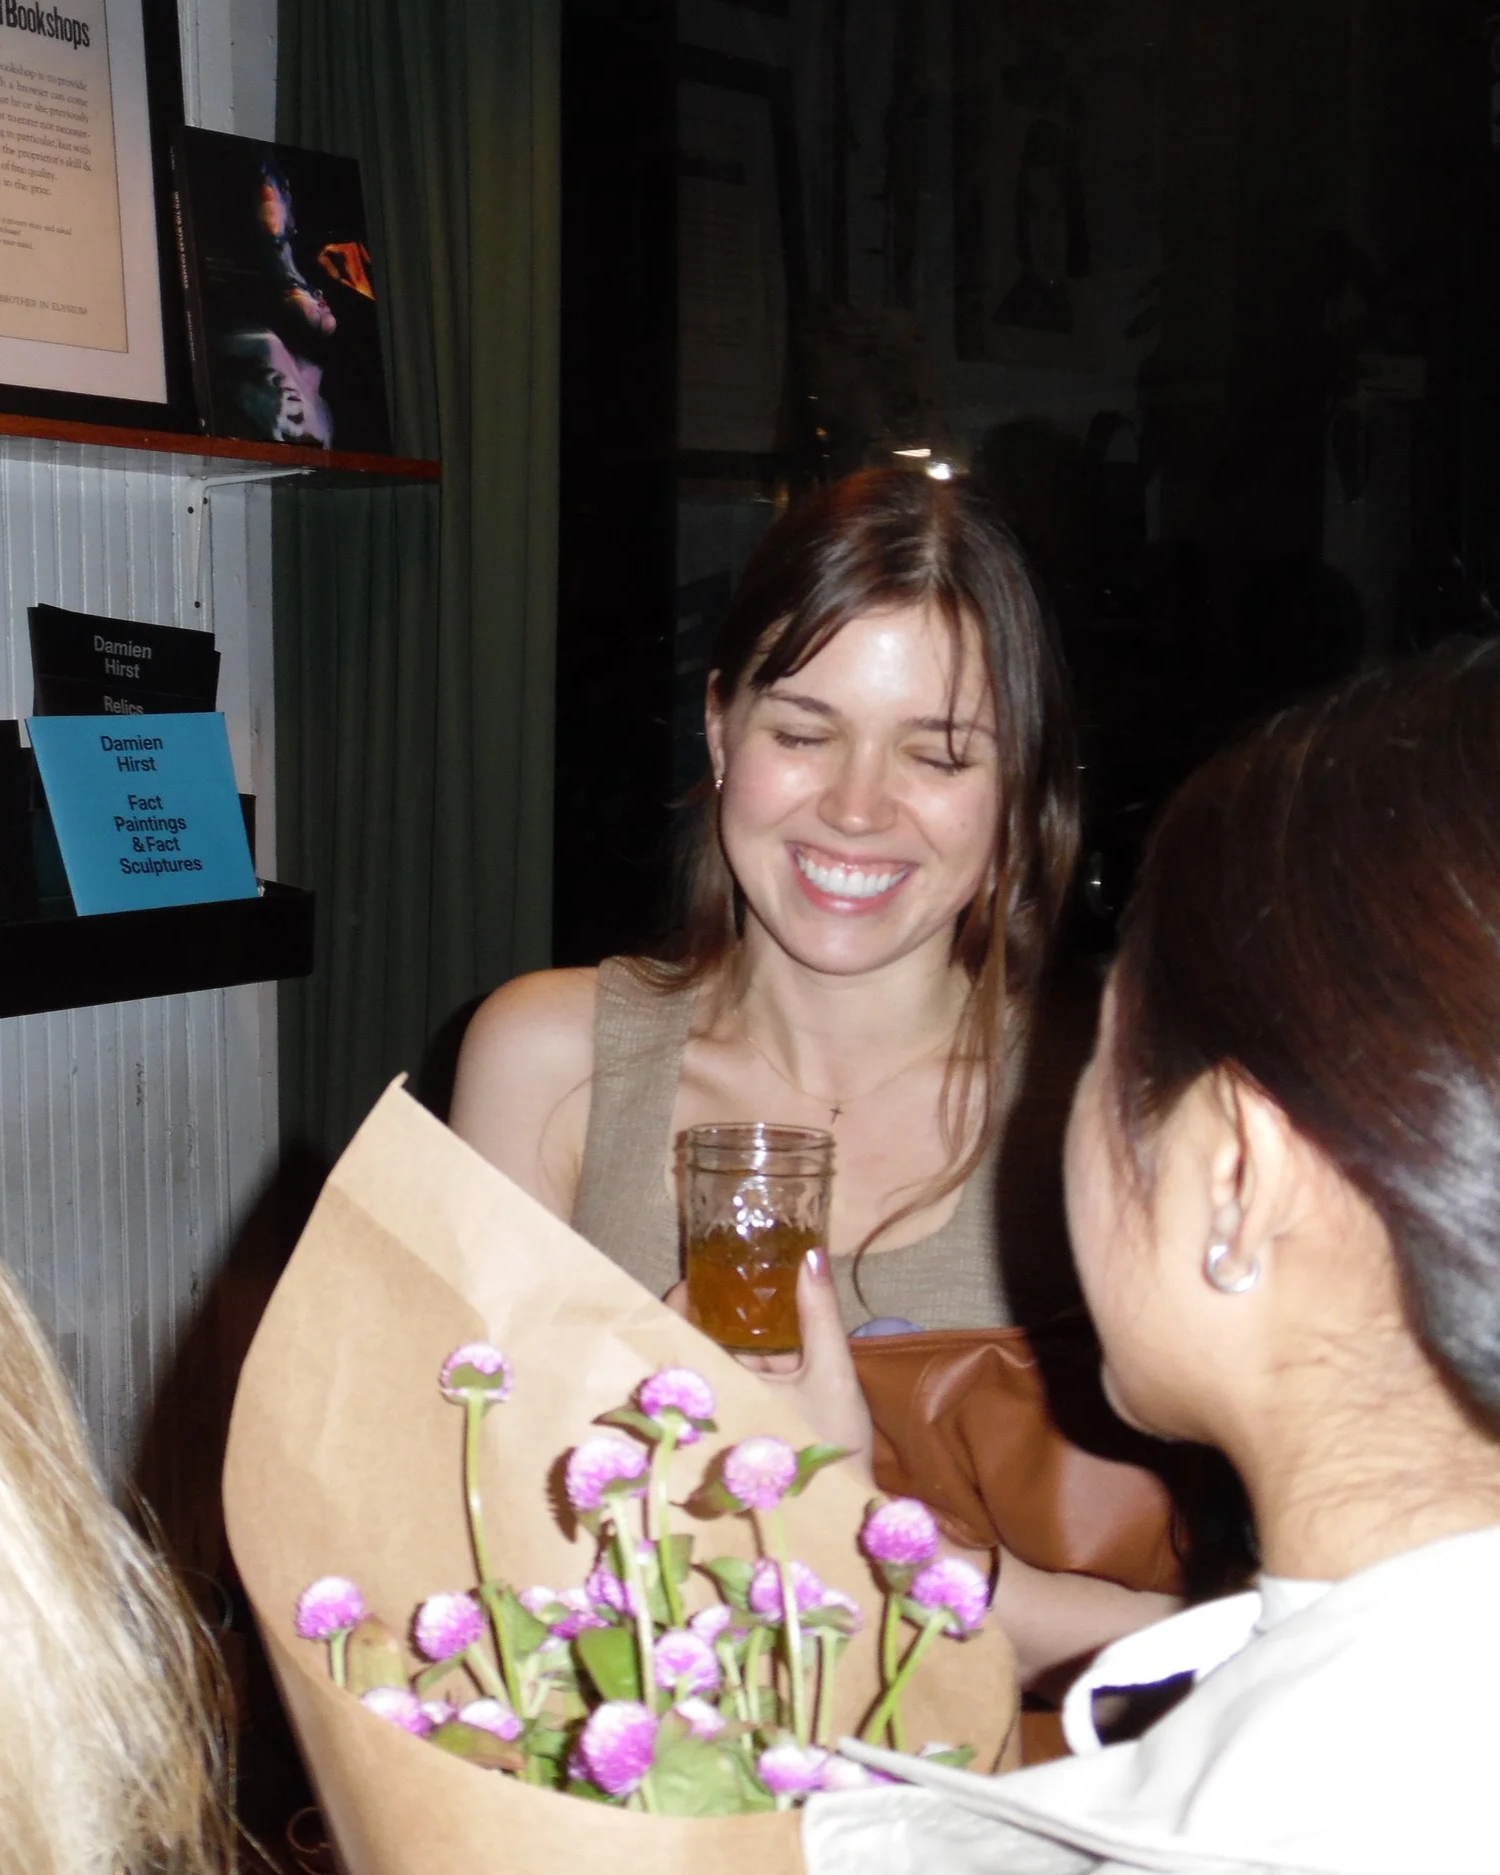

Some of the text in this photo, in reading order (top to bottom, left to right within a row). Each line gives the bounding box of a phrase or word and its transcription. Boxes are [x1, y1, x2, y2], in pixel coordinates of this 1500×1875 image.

[5, 0, 90, 50] Bookshops
[0, 62, 36, 80] ookshop
[46, 73, 56, 82] to
[57, 77, 88, 91] provide
[16, 80, 48, 97] browser
[50, 91, 65, 101] can
[67, 95, 88, 107] come
[7, 113, 16, 122] to
[17, 117, 38, 128] enter
[40, 121, 54, 131] not
[22, 101, 32, 110] or
[34, 101, 48, 114] she
[49, 107, 89, 124] previously
[2, 143, 16, 155] the
[83, 160, 92, 171] &
[73, 144, 91, 155] with
[1, 160, 10, 170] of
[14, 178, 28, 191] the
[39, 300, 49, 310] IN
[51, 301, 88, 315] ELYSIUM
[94, 635, 152, 659] Damien
[104, 658, 140, 679] Hirst
[103, 695, 144, 715] Relics
[100, 735, 163, 752] Damien
[116, 756, 157, 772] Hirst
[127, 794, 164, 811] Fact
[114, 815, 187, 834] Paintings
[120, 857, 203, 876] Sculptures
